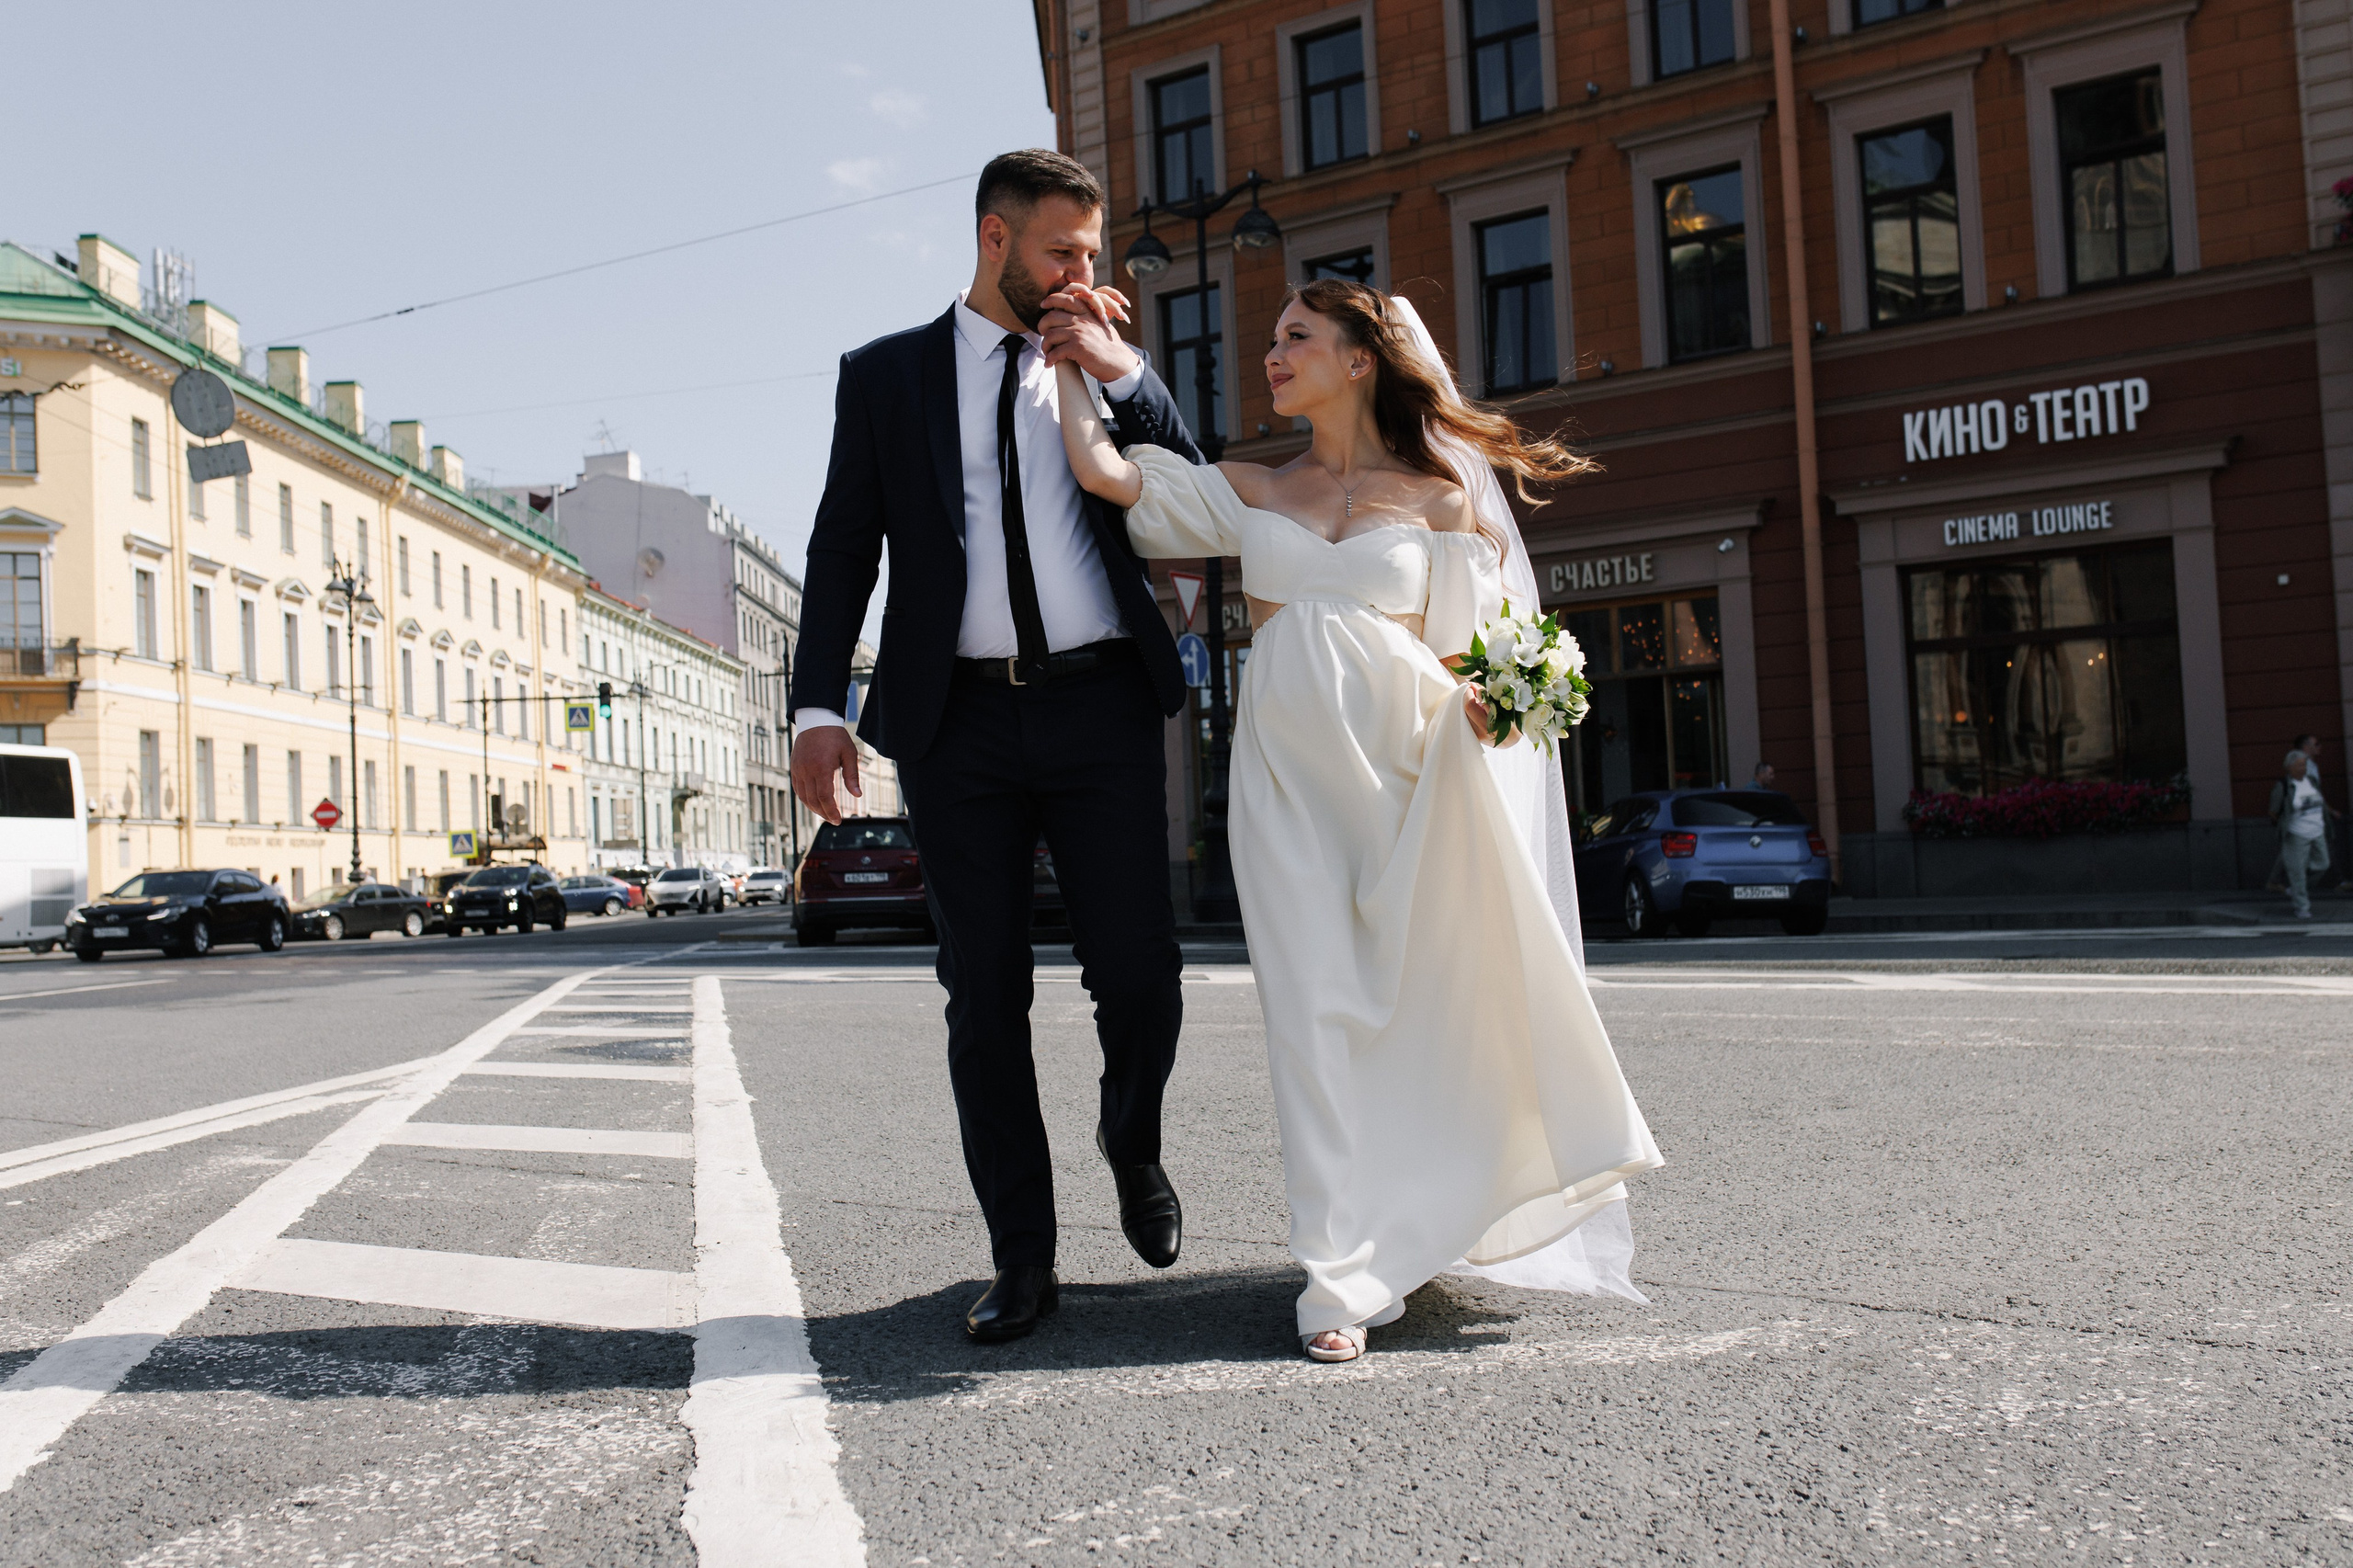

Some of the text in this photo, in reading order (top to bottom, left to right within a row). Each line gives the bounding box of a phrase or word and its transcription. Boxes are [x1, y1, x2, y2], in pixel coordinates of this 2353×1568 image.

[1903, 377, 2150, 462] КИНО & ТЕАТР
[1943, 501, 2113, 547] CINEMA LOUNGE
[1550, 552, 1654, 593] СЧАСТЬЕ
